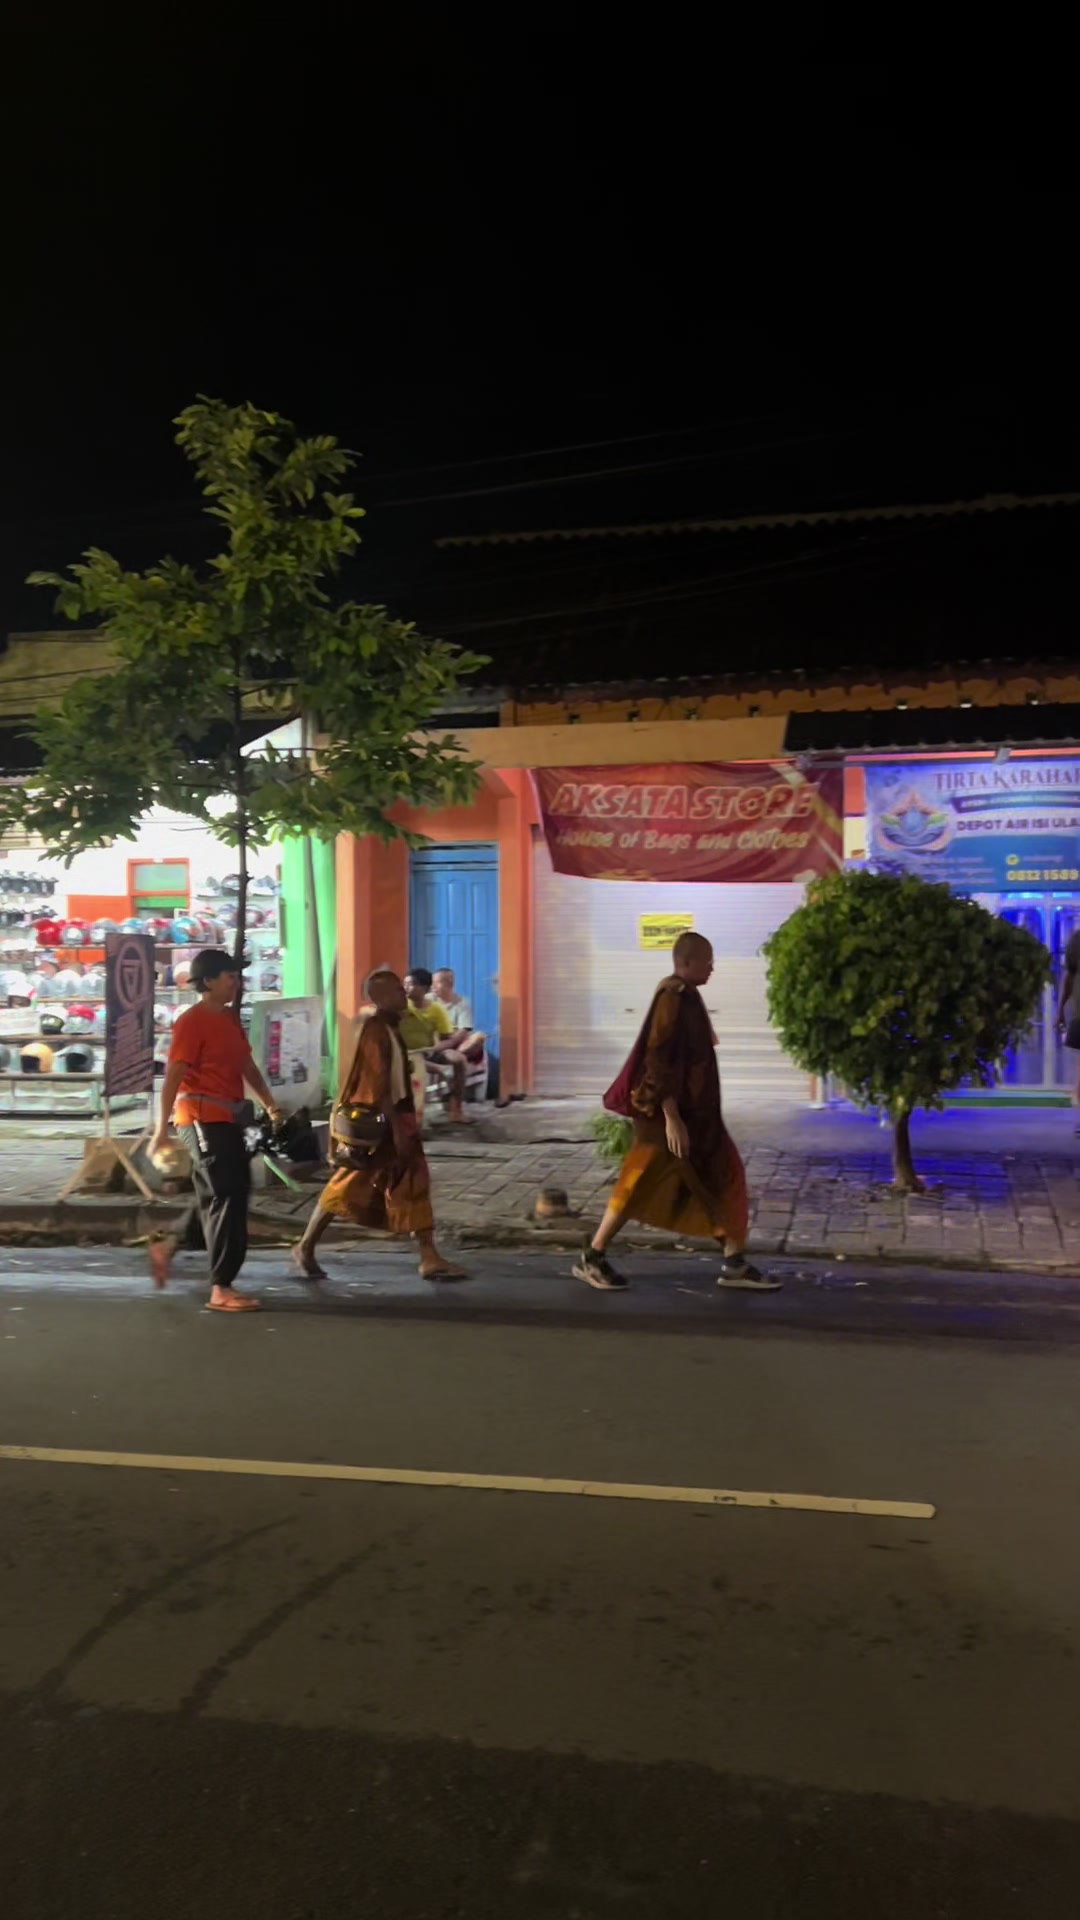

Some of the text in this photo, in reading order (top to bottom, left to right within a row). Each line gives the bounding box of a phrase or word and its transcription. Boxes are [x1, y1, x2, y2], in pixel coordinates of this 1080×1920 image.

[935, 772, 987, 791] TIRTA
[549, 783, 817, 819] AKSATA STORE
[956, 819, 1002, 831] DEPOT
[1006, 818, 1028, 829] AIR
[619, 830, 641, 848] of
[644, 830, 689, 854] Bags
